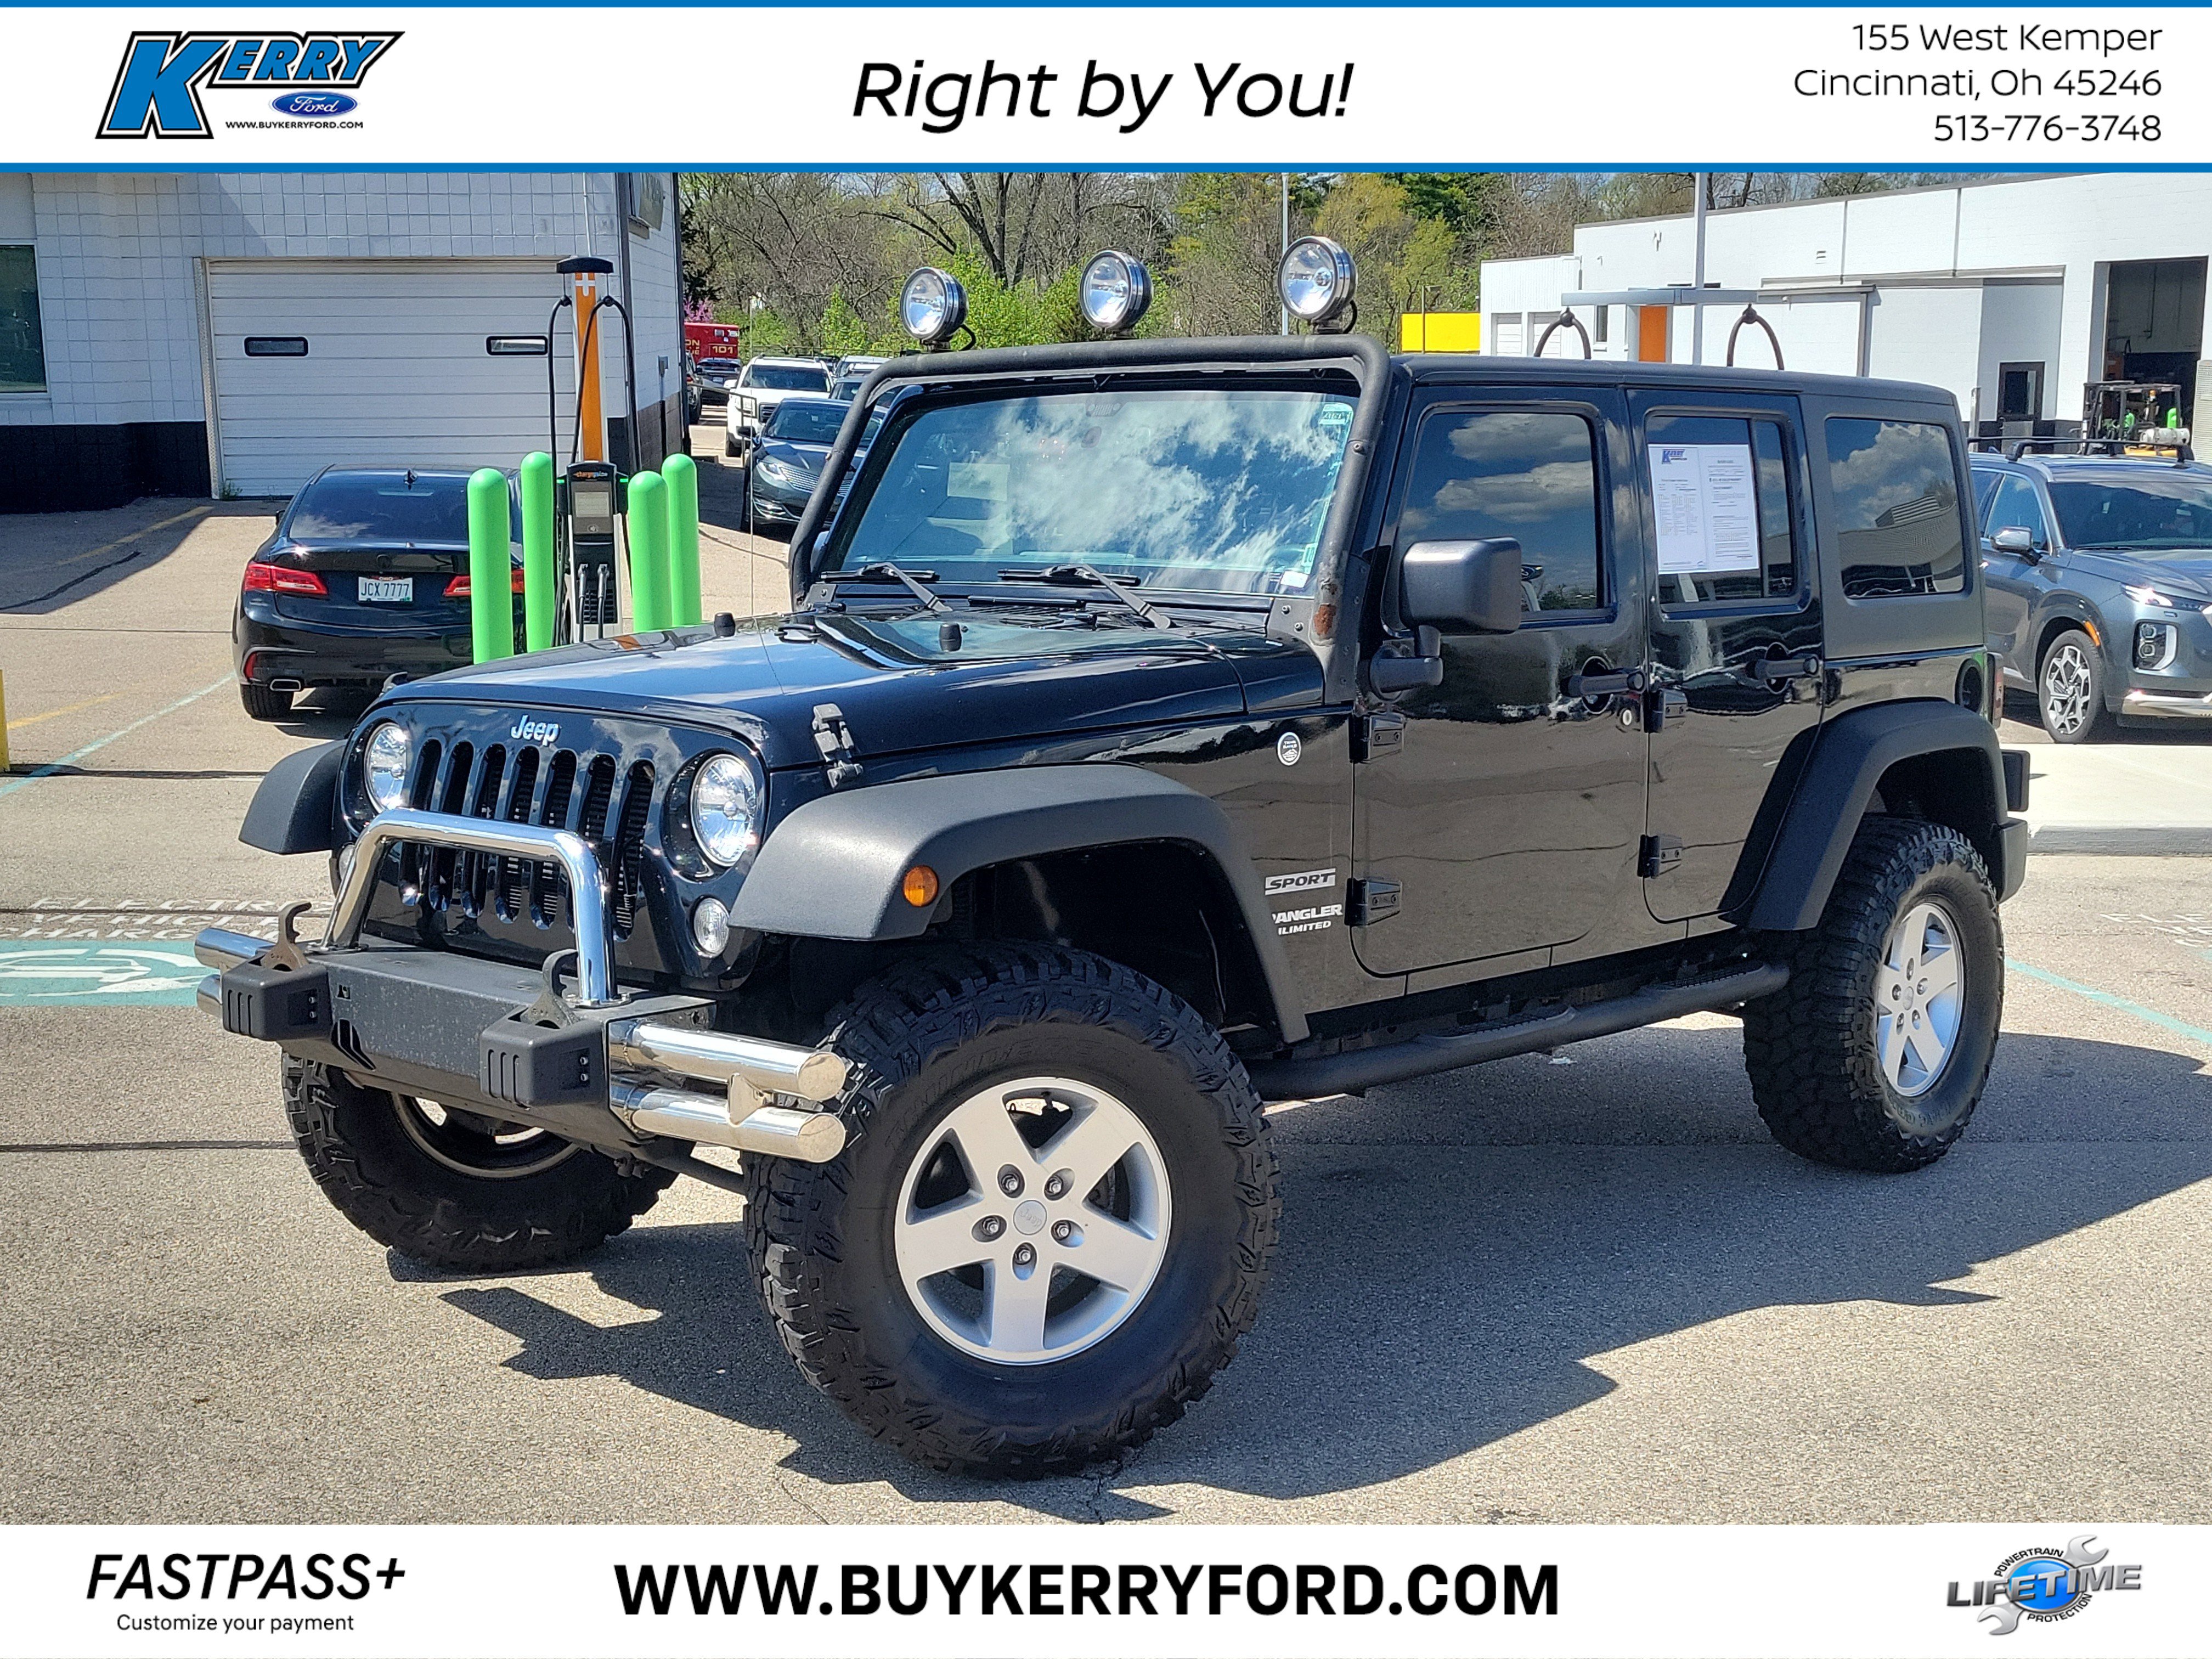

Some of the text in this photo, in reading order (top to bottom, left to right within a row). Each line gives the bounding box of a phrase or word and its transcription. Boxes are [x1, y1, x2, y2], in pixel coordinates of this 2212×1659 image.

[712, 346, 733, 354] 101
[360, 582, 409, 597] JCX 7777
[511, 714, 560, 746] Jeep
[1266, 872, 1335, 890] SPORT
[1272, 904, 1343, 924] ANGLER
